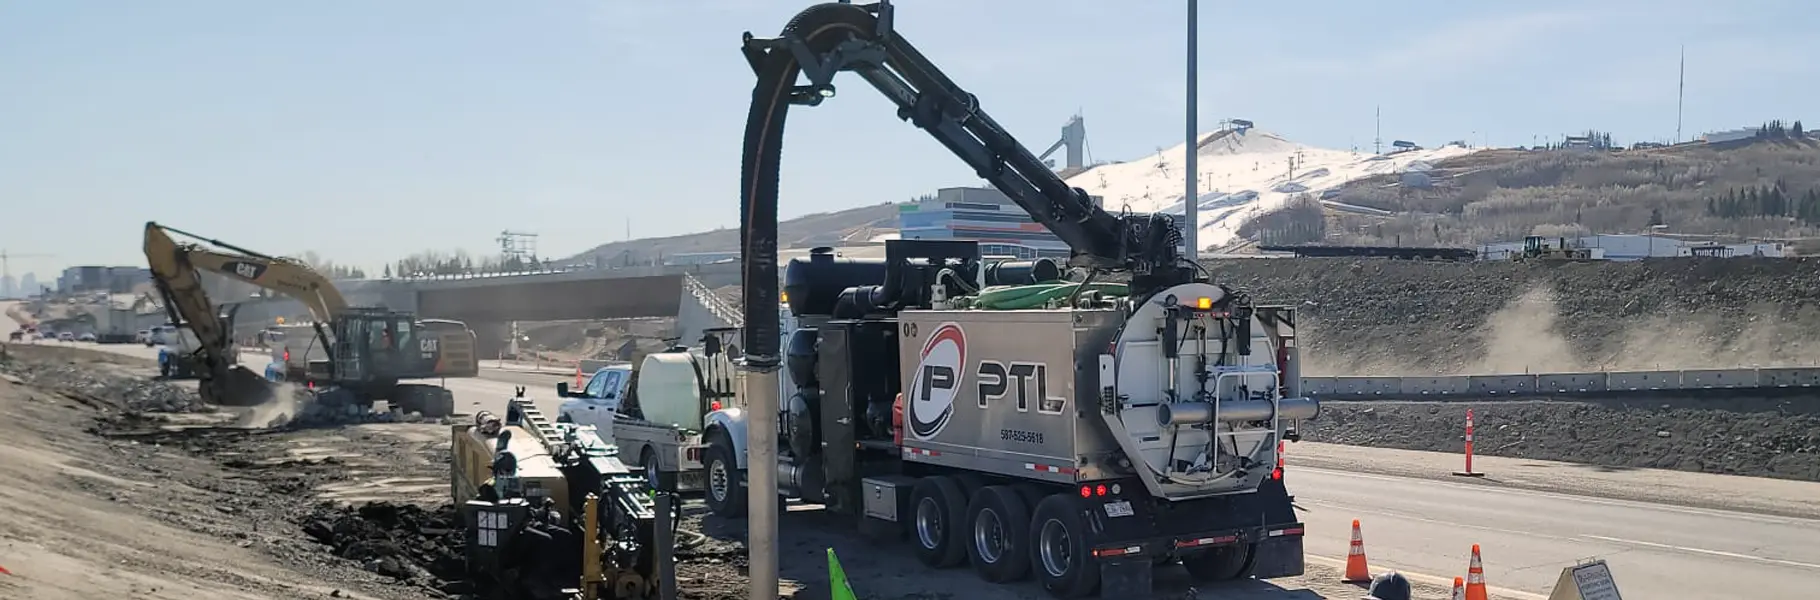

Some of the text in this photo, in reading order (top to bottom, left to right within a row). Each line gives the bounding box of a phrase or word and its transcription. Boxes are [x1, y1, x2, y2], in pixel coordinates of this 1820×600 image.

[236, 262, 256, 278] CAT
[420, 339, 438, 352] CAT
[977, 360, 1066, 415] PTL
